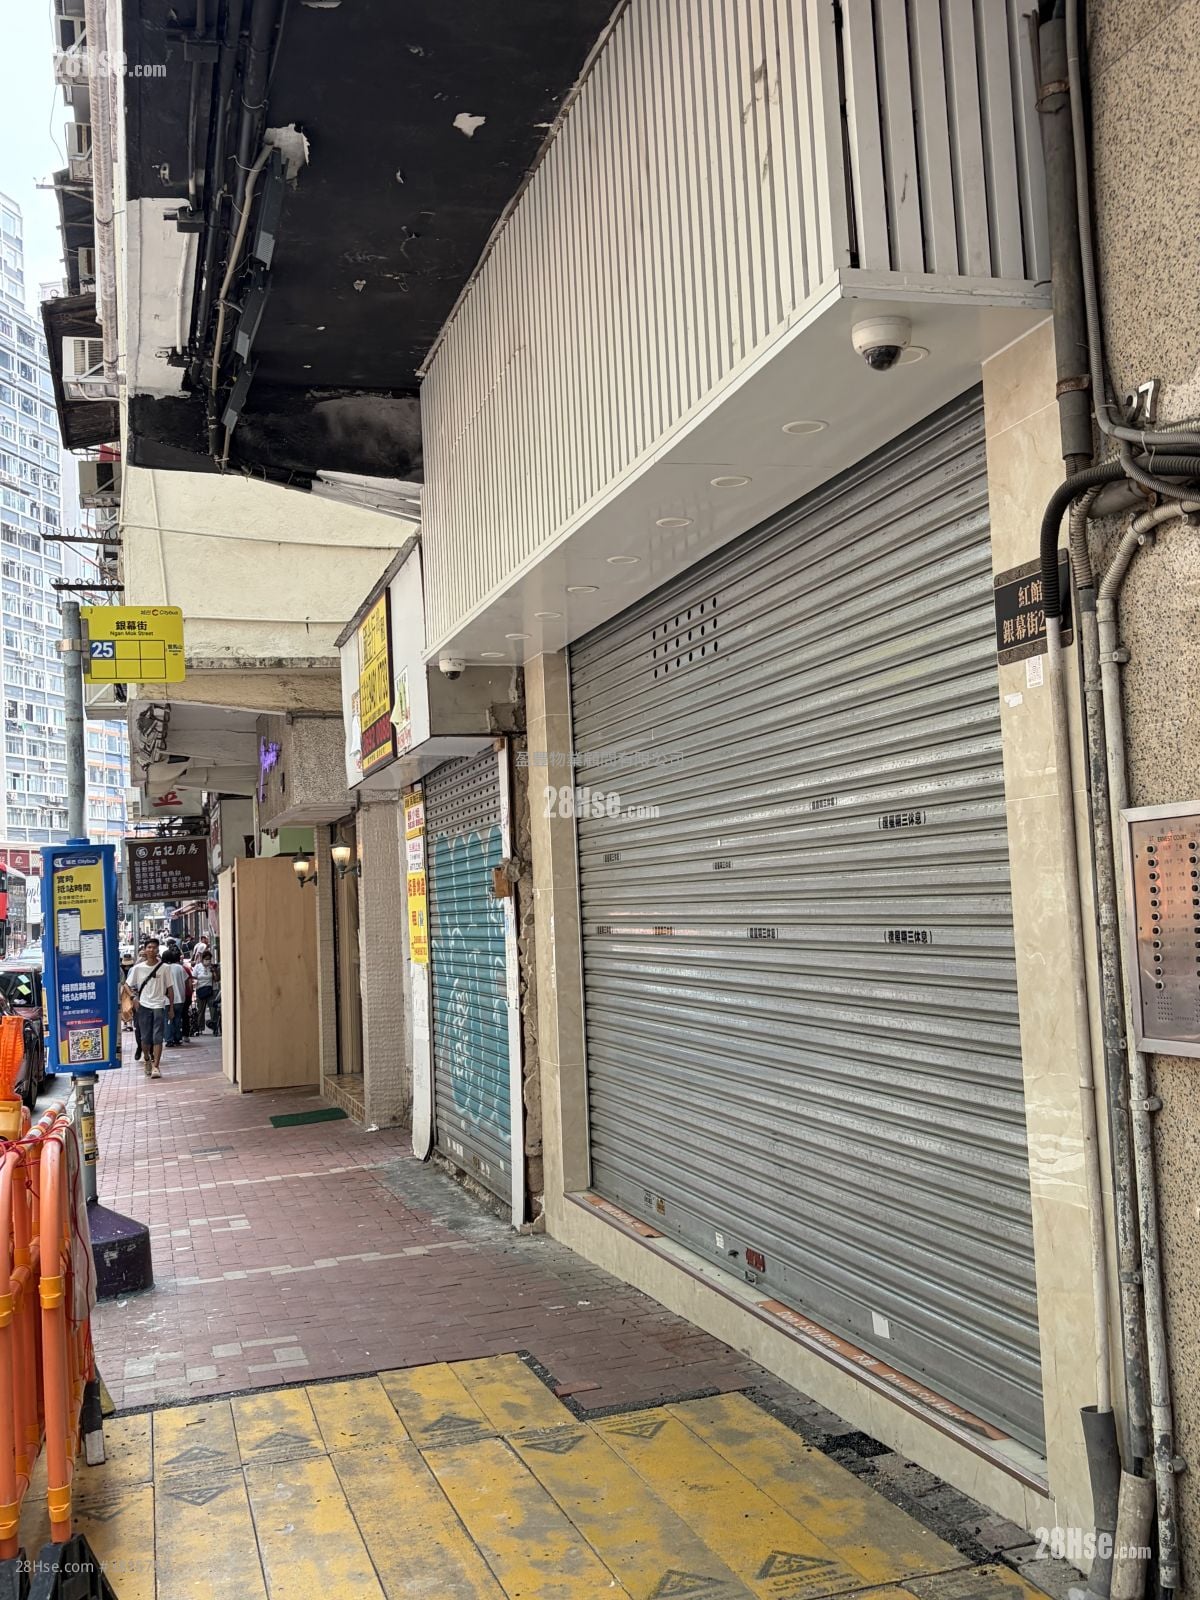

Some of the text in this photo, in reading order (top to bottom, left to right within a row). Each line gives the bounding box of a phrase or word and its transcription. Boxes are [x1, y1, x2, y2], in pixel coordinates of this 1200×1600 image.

[115, 620, 147, 630] 銀幕街
[1003, 609, 1063, 644] 銀幕街2
[91, 642, 113, 657] 25
[152, 843, 199, 857] 石記廚房
